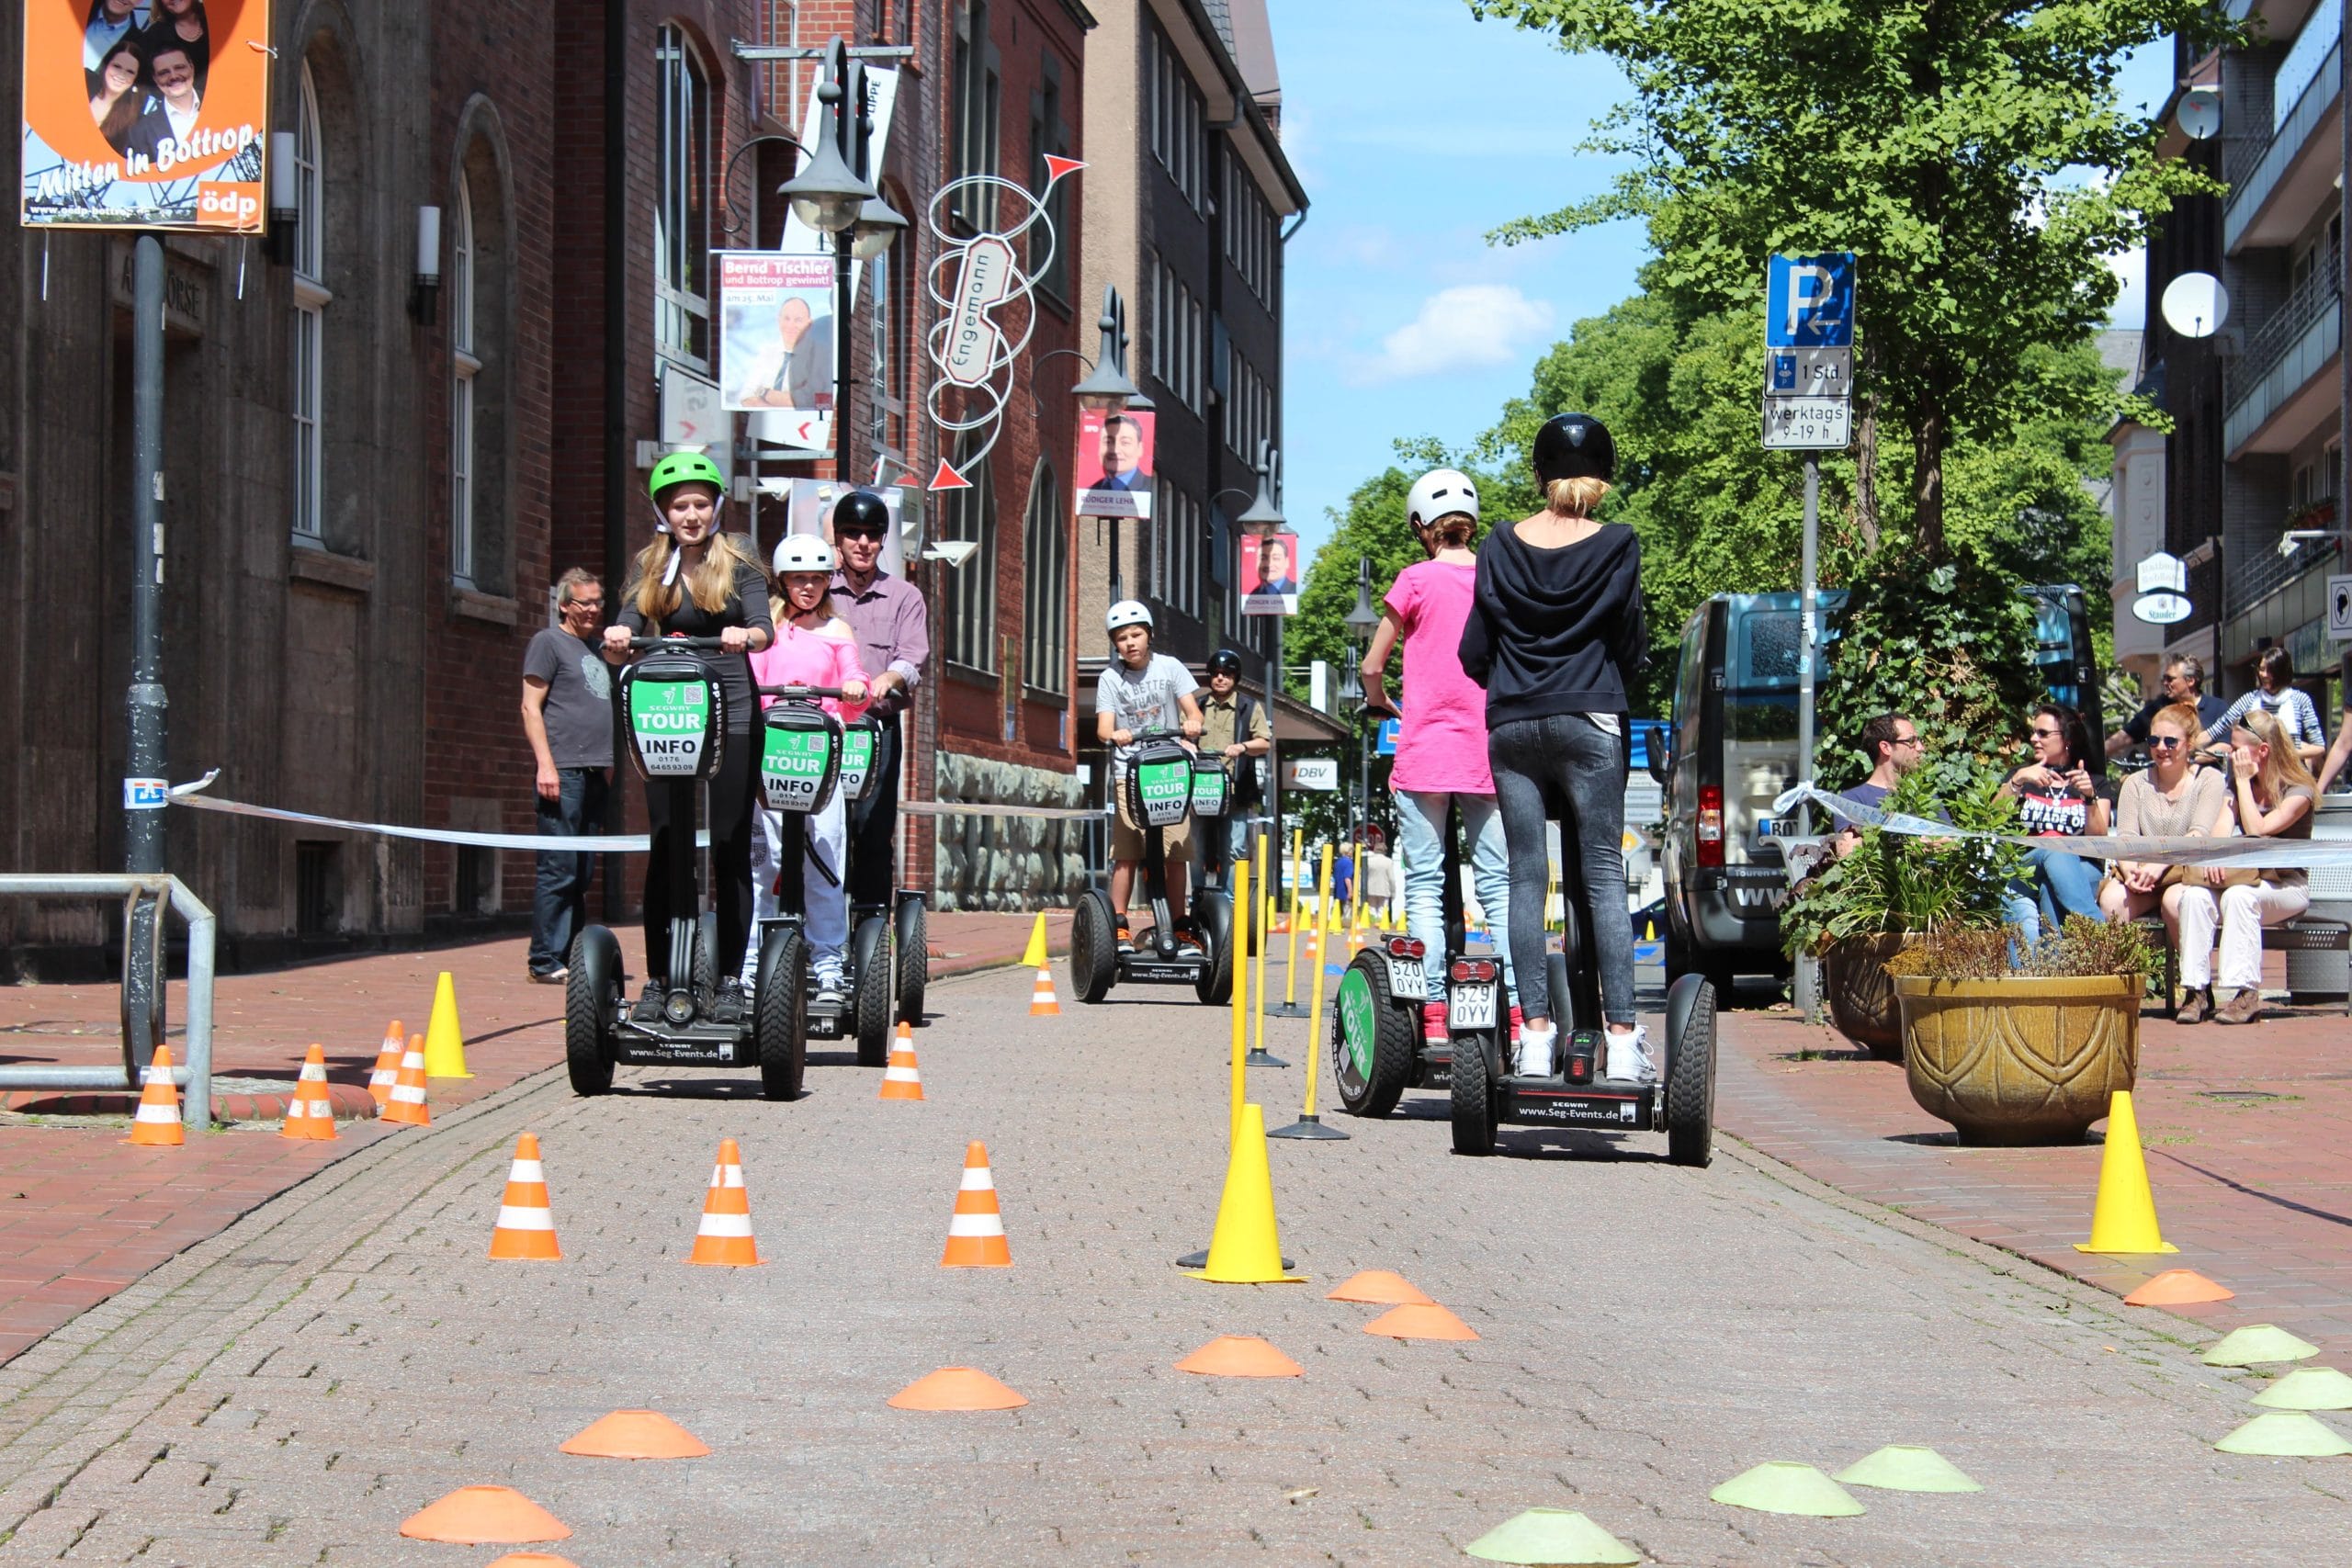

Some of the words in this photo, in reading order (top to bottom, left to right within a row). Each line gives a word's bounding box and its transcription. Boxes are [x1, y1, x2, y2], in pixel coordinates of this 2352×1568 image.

[35, 161, 119, 202] Mitten
[126, 147, 150, 176] in
[157, 123, 254, 172] Bottrop
[201, 190, 256, 219] ödp
[725, 262, 768, 274] Bernd
[775, 262, 830, 275] Tischler
[725, 276, 744, 285] und
[747, 276, 783, 287] Bottrop
[786, 276, 829, 287] gewinnt!
[756, 294, 774, 302] Mai
[1787, 265, 1834, 335] P
[952, 254, 989, 367] Engemann
[1814, 365, 1843, 379] Std.
[1770, 405, 1844, 423] werktags
[1782, 426, 1815, 439] 9-19
[1822, 426, 1830, 439] h
[1132, 679, 1171, 695] BETTER
[1132, 693, 1159, 709] THAN
[638, 714, 701, 729] TOUR
[646, 740, 695, 753] INFO
[765, 755, 820, 773] TOUR
[1298, 768, 1327, 777] DBV
[769, 778, 814, 794] INFO
[1145, 783, 1185, 796] TOUR
[1194, 787, 1220, 795] TOUR
[1150, 800, 1182, 812] INFO
[2024, 797, 2086, 817] UNIVERSE
[2020, 809, 2030, 820] IS
[2032, 810, 2068, 825] MADE
[2072, 816, 2085, 827] OF
[1355, 832, 1382, 850] SOP
[1735, 869, 1770, 877] Touren
[1391, 962, 1420, 976] 520
[1396, 976, 1423, 994] OYY
[1456, 986, 1490, 1003] 529
[1456, 1006, 1490, 1022] OYY
[1342, 990, 1367, 1073] TOUR
[629, 1049, 718, 1059] www.Seg-Events.de
[1519, 1108, 1619, 1120] www.Seg-Events.de
